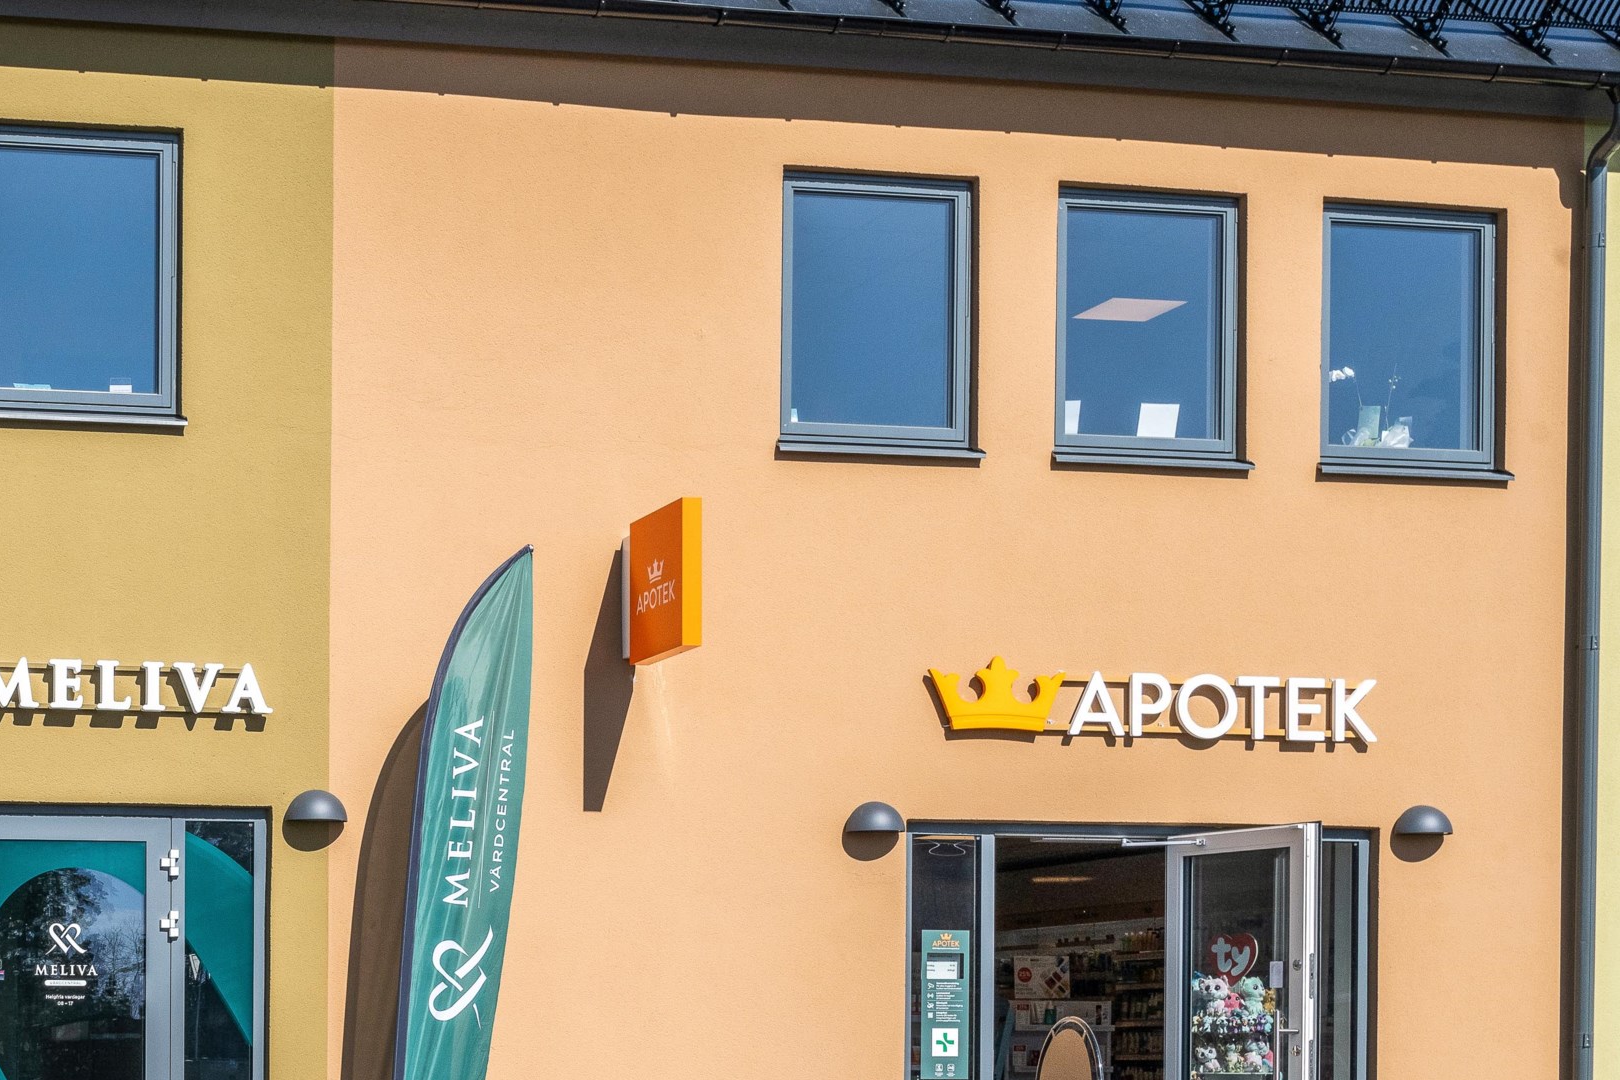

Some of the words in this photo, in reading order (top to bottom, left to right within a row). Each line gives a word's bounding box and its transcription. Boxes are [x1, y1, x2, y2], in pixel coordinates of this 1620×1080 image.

[636, 579, 676, 616] APOTEK
[1067, 670, 1377, 743] APOTEK
[443, 715, 484, 908] MELIVA
[489, 729, 515, 893] VÅRDCENTRAL
[34, 964, 99, 976] MELIVA
[1211, 937, 1251, 977] ty
